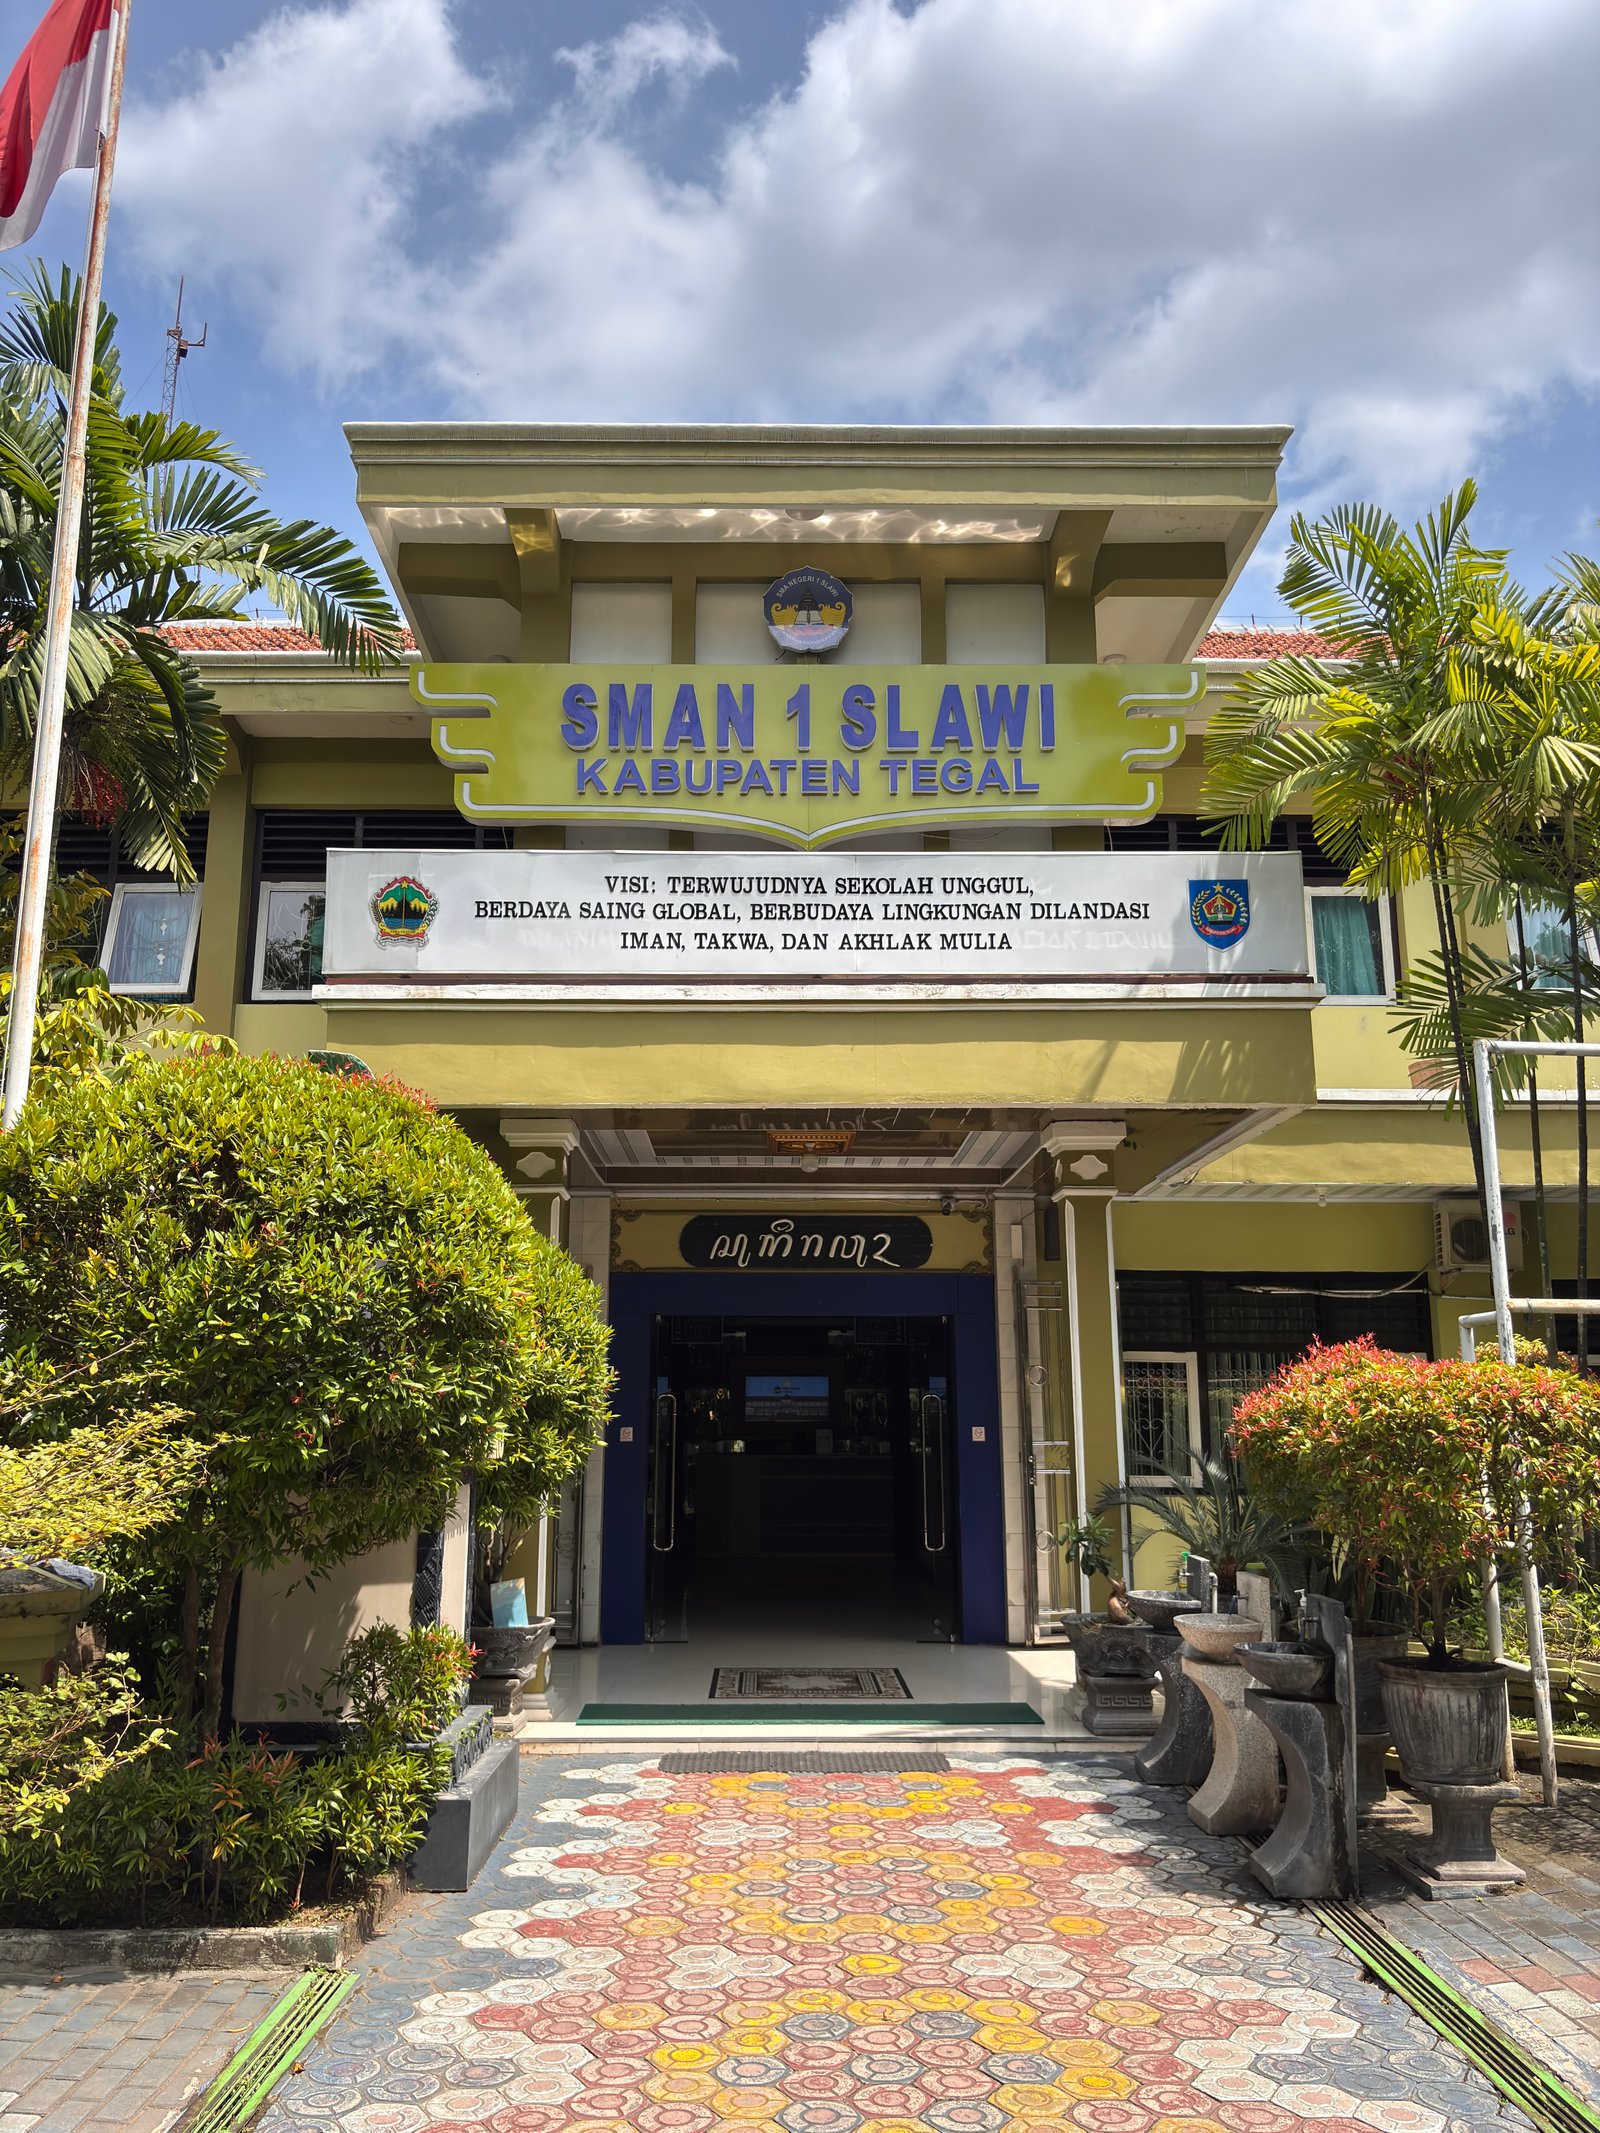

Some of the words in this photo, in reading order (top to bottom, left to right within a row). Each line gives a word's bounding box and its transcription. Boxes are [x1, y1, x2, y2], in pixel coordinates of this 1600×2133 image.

[776, 584, 789, 598] SMA
[788, 576, 815, 587] NEGERI
[821, 580, 839, 597] SLAWI
[560, 683, 755, 751] SMAN
[786, 684, 811, 750] 1
[840, 684, 1055, 752] SLAWI
[577, 758, 862, 795] KABUPATEN
[880, 758, 1040, 794] TEGAL
[604, 876, 656, 894] VISI:
[667, 877, 827, 895] TERWUJUDNYA
[835, 877, 934, 895] SEKOLAH
[941, 876, 1034, 897] UNGGUL,
[474, 901, 572, 919] BERDAYA
[579, 902, 646, 920] SAING
[652, 903, 741, 923] GLOBAL,
[750, 903, 874, 921] BERBUDAYA
[882, 903, 1022, 921] LINGKUNGAN
[1030, 902, 1150, 920] DILANDASI
[620, 933, 686, 952] IMAN,
[694, 932, 774, 953] TAKWA,
[781, 933, 829, 950] DAN
[838, 933, 933, 950] AKHLAK
[940, 932, 1012, 950] MULIA
